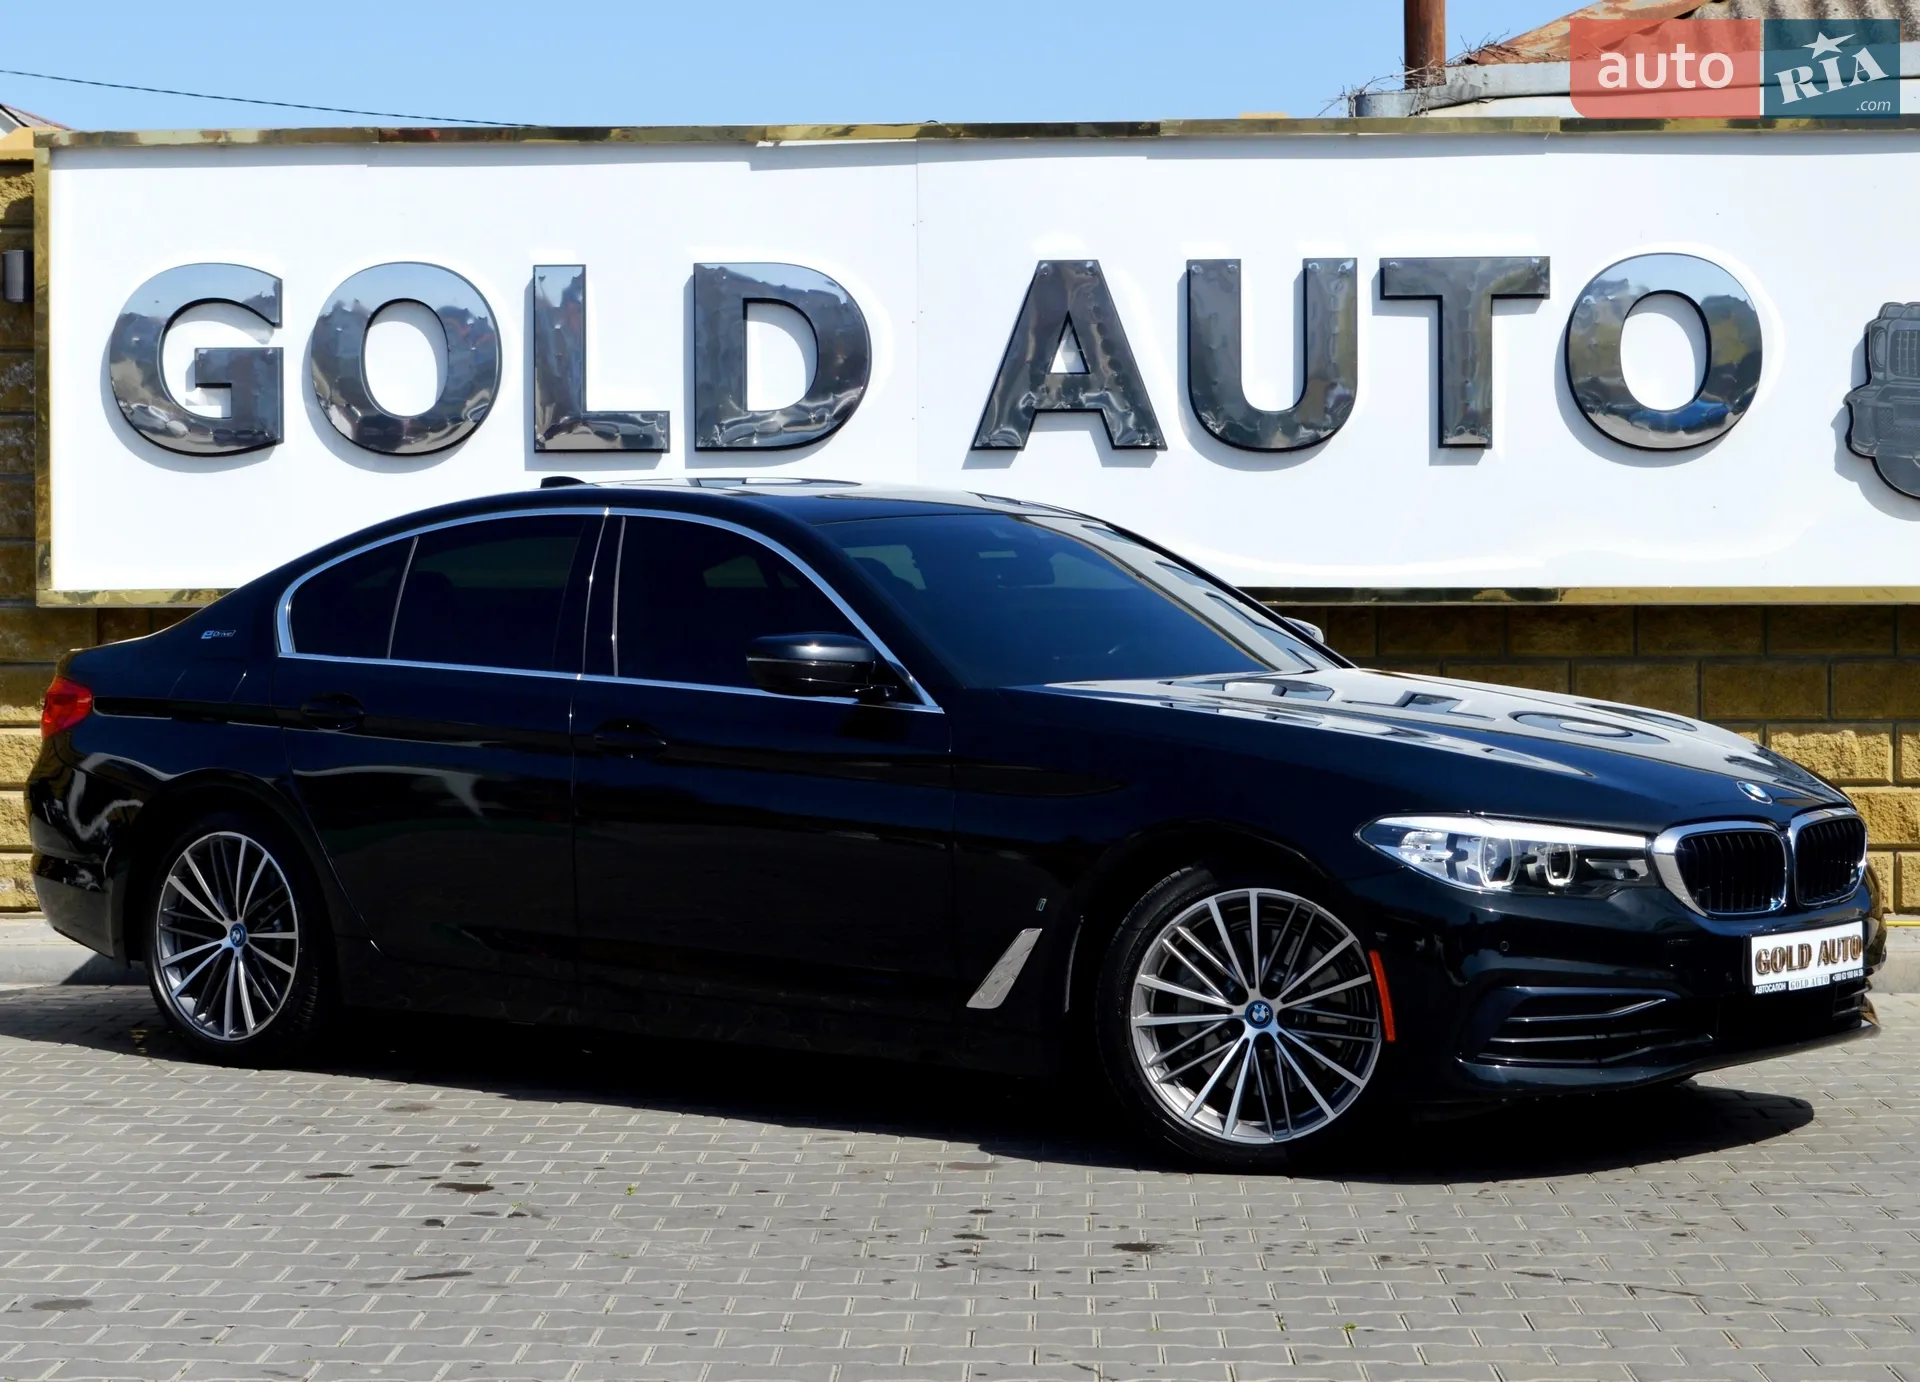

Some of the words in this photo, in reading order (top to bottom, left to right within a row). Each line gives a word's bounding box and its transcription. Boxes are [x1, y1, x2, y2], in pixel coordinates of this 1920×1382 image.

[108, 261, 873, 457] GOLD
[970, 252, 1763, 452] AUTO
[1755, 943, 1812, 975] GOLD
[1817, 934, 1863, 968] AUTO
[1790, 979, 1809, 989] GOLD
[1811, 975, 1829, 985] AUTO
